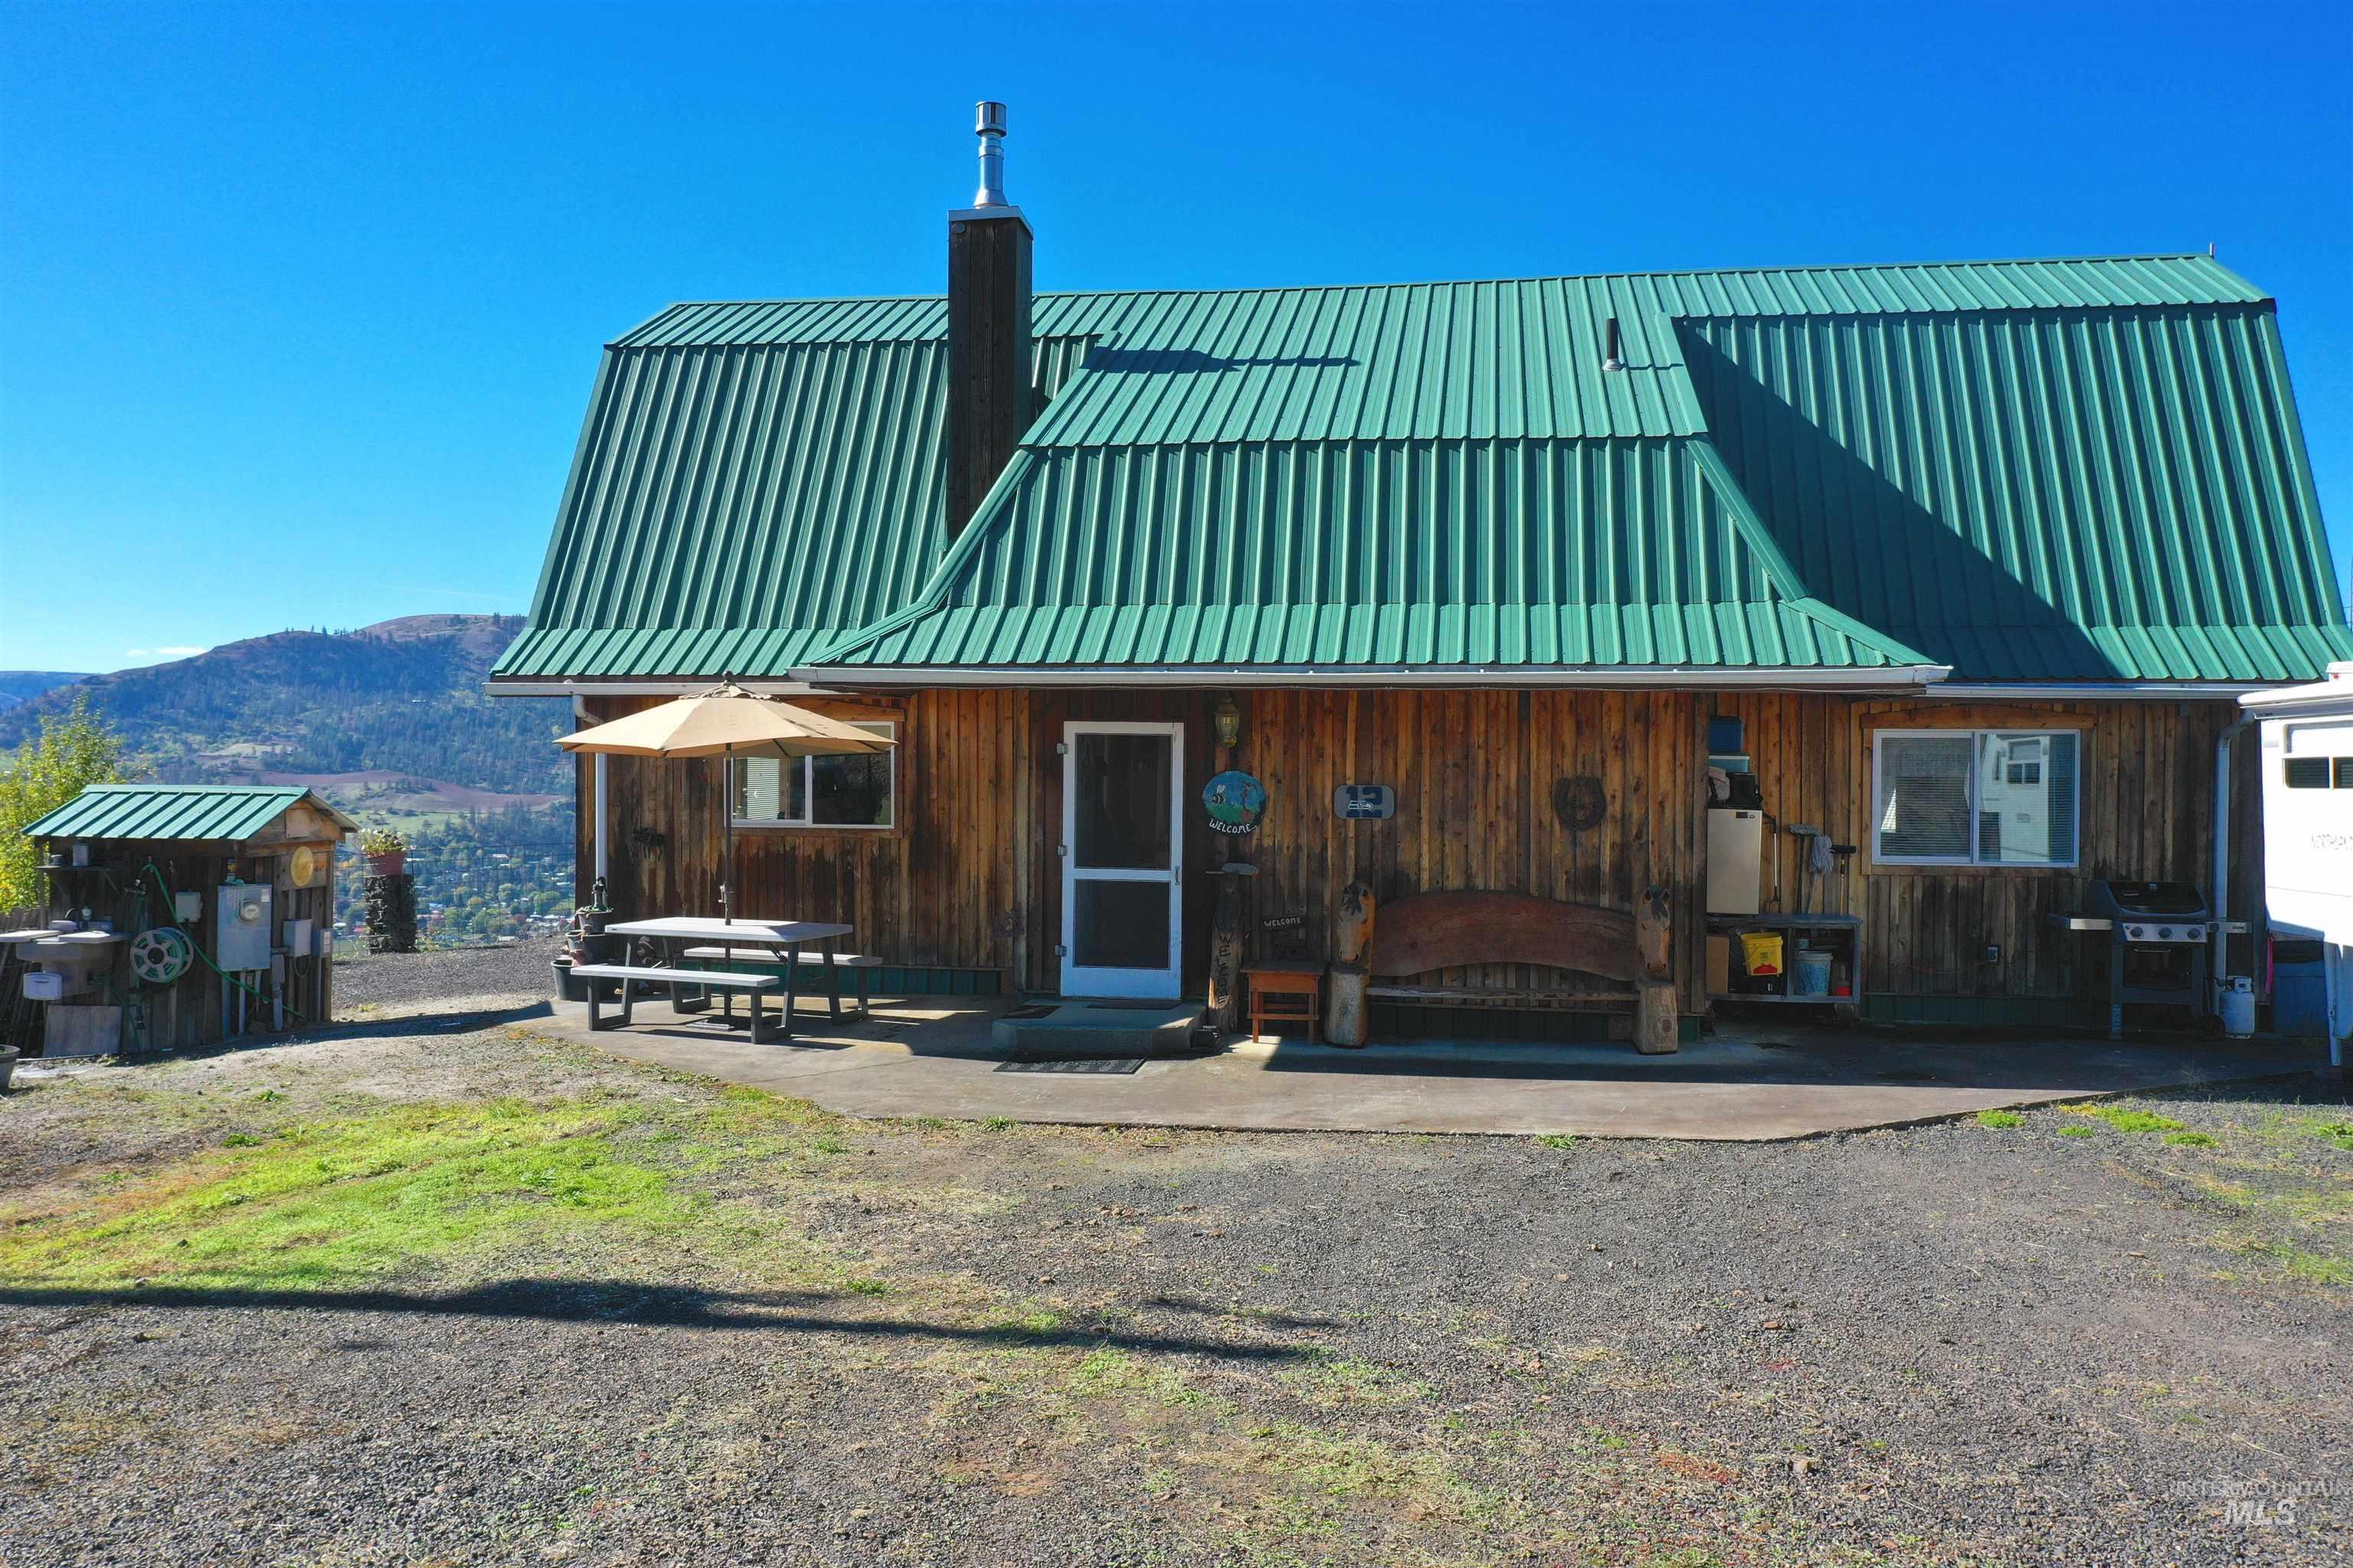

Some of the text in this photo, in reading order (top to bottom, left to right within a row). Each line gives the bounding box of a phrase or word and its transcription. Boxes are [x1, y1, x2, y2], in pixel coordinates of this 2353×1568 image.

[1347, 787, 1383, 817] 12
[1209, 817, 1257, 833] WELCOME
[1264, 917, 1302, 927] WELCOME
